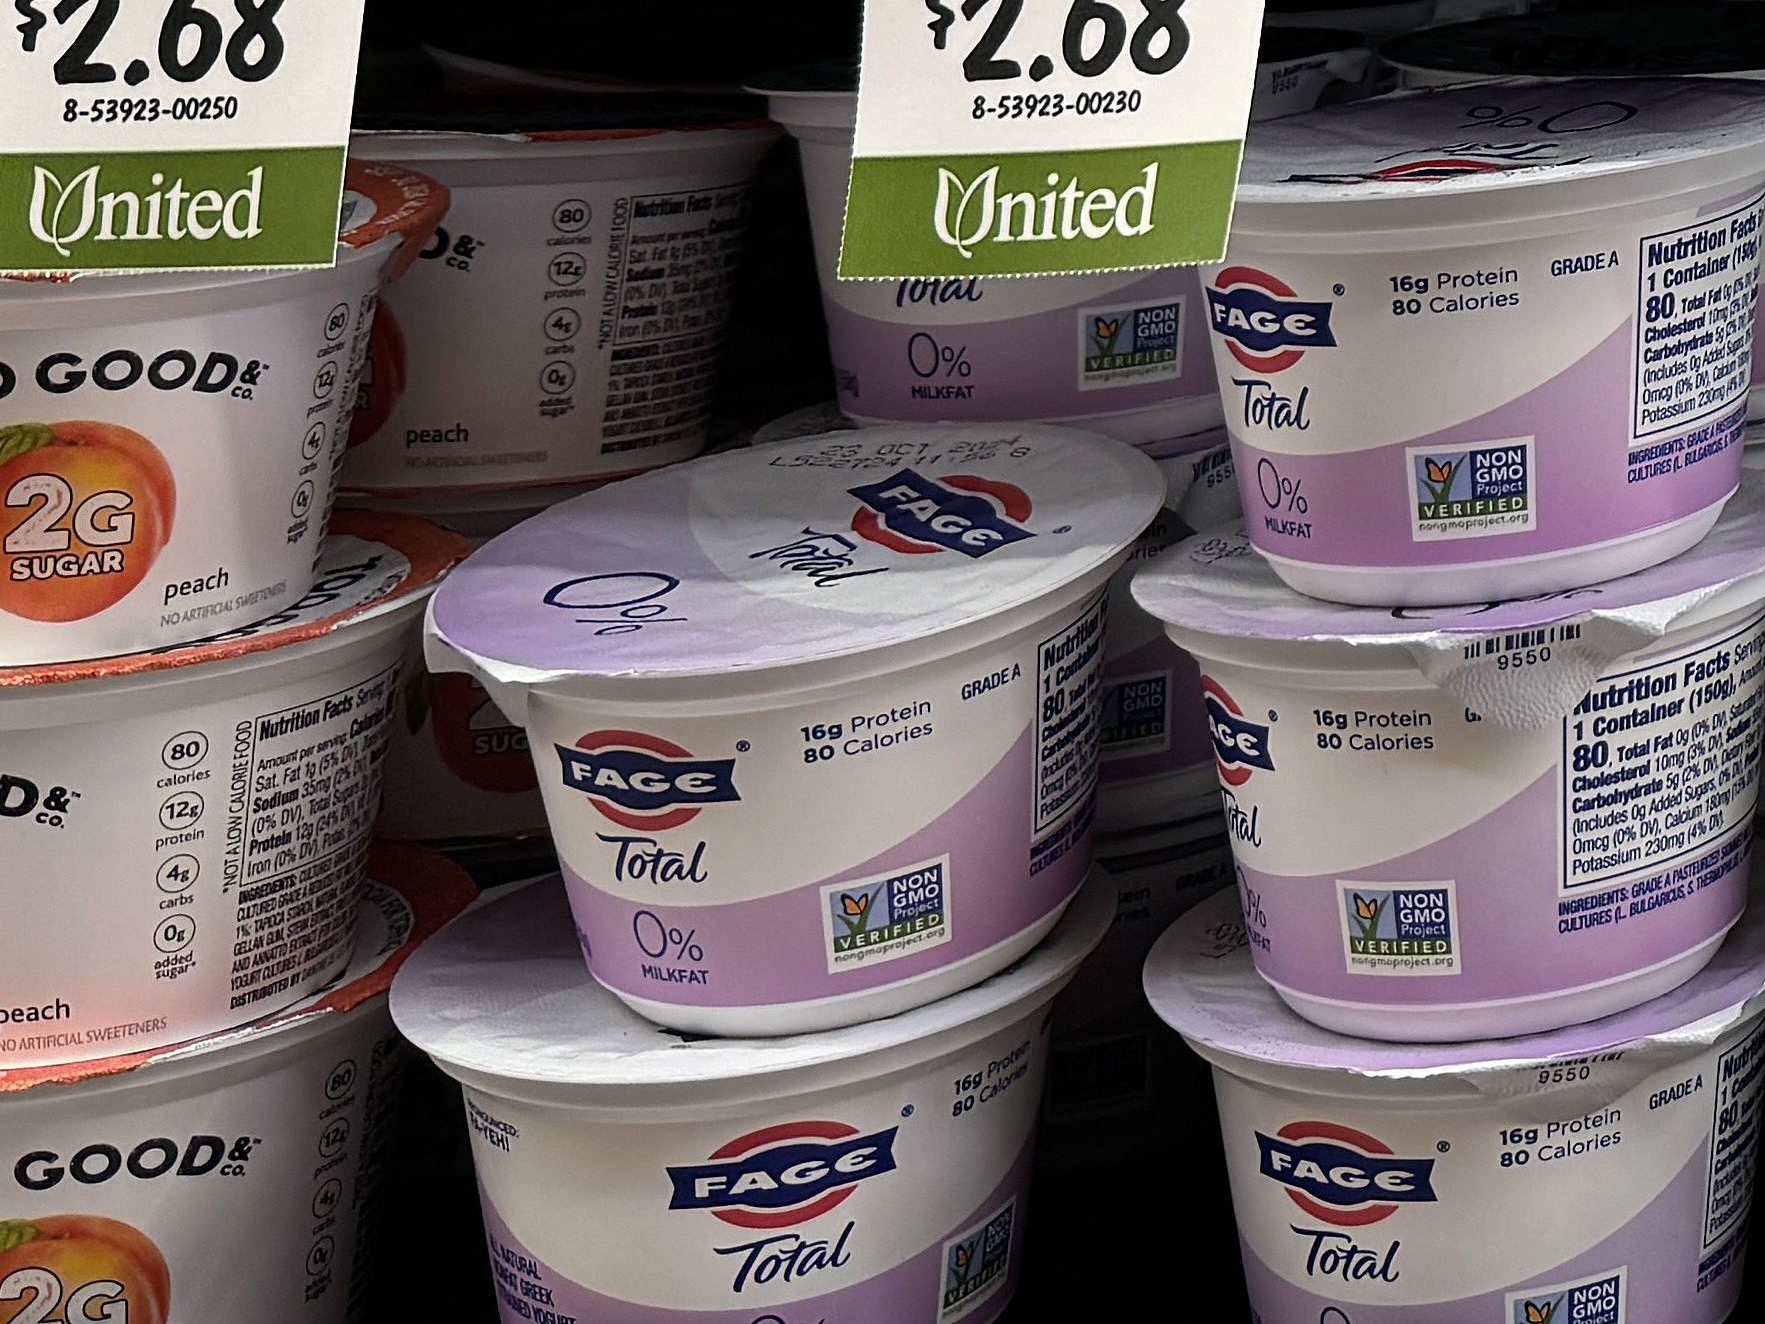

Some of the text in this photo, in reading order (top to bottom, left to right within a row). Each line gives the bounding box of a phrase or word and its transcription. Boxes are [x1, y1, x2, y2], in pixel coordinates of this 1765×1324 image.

[63, 97, 238, 123] 8-53923-00250
[972, 90, 1141, 119] 8-53923-00230
[29, 166, 263, 257] United
[934, 162, 1158, 258] United
[36, 349, 238, 393] GOOD
[1477, 449, 1522, 467] NON
[1476, 466, 1524, 482] GMO
[1478, 481, 1523, 495] Project
[4, 473, 136, 553] 2G
[1424, 497, 1523, 517] VERIFIED
[11, 550, 124, 580] SUGAR
[165, 569, 230, 605] peach
